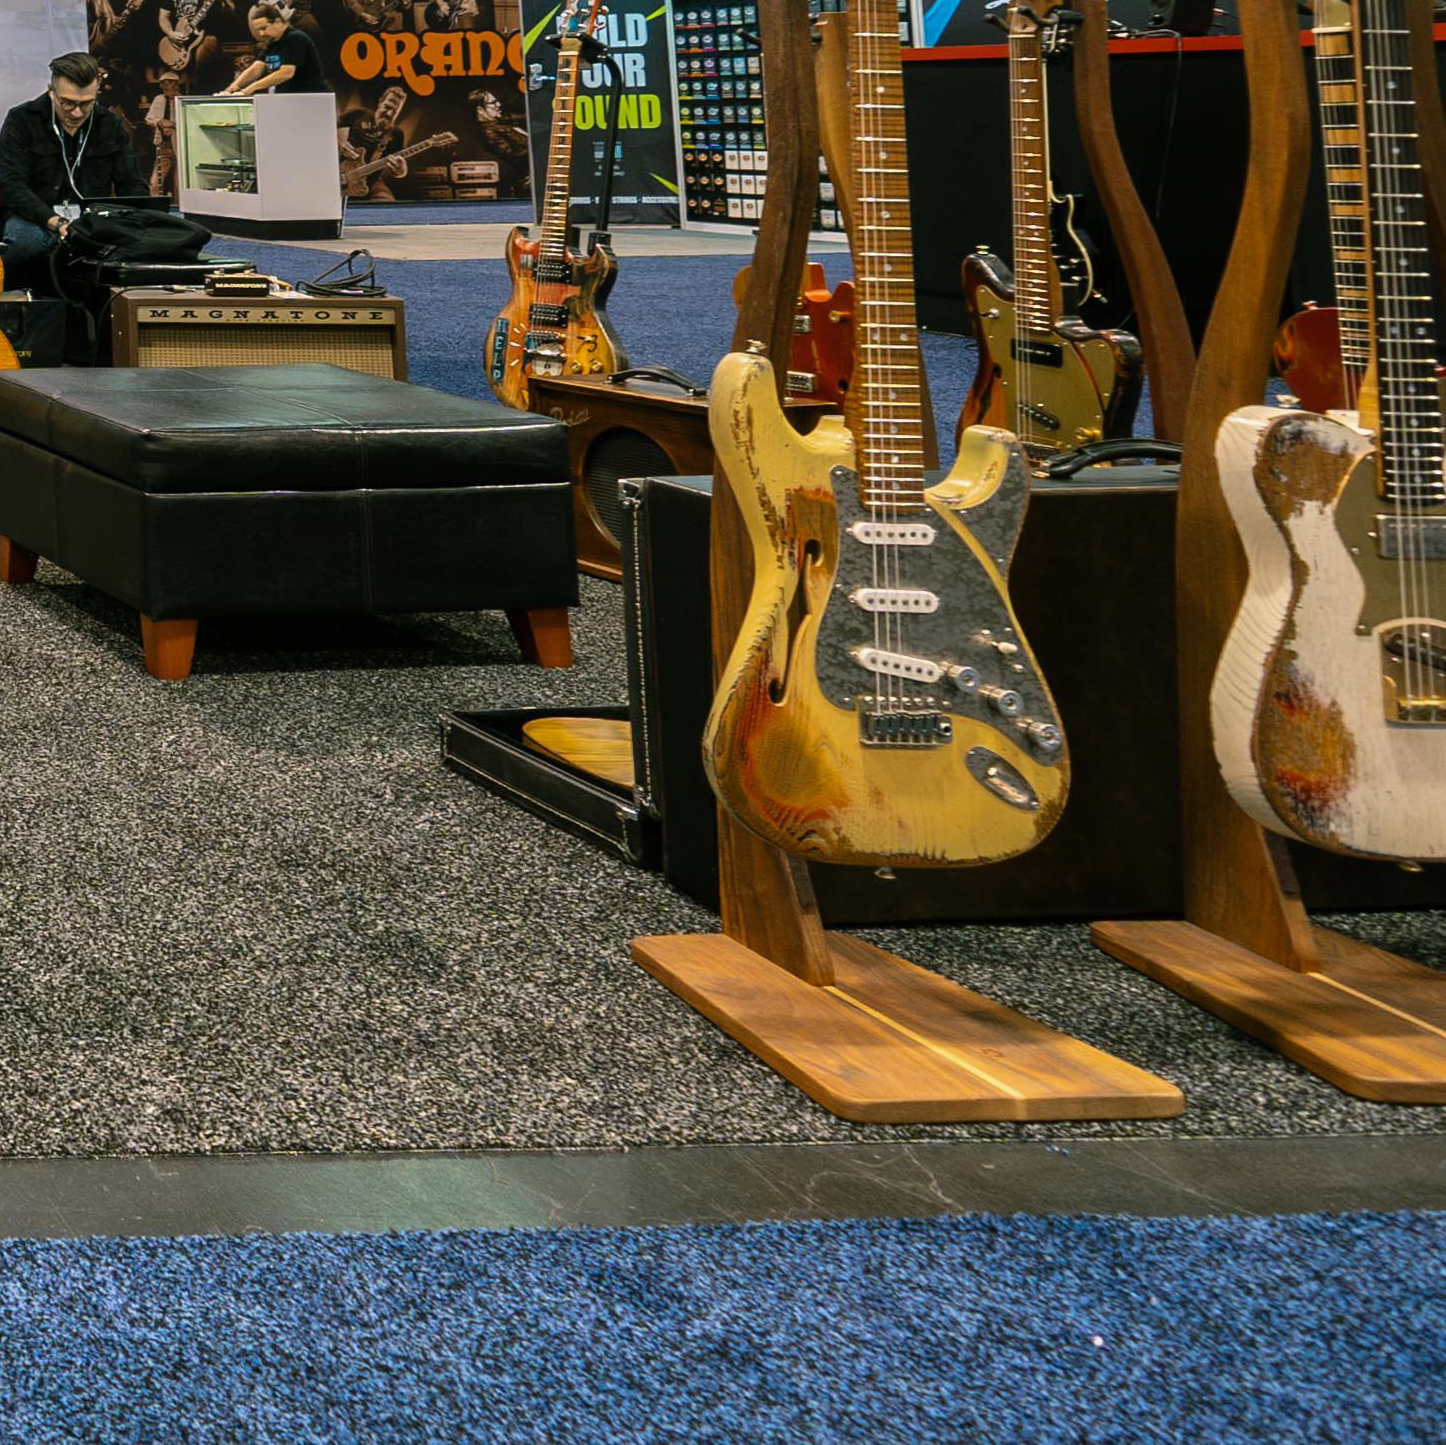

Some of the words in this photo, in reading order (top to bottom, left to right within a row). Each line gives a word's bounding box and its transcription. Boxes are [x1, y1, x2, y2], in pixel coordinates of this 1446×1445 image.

[340, 30, 525, 97] ORAN
[552, 93, 662, 131] OUND
[149, 309, 383, 320] MAGNATONE
